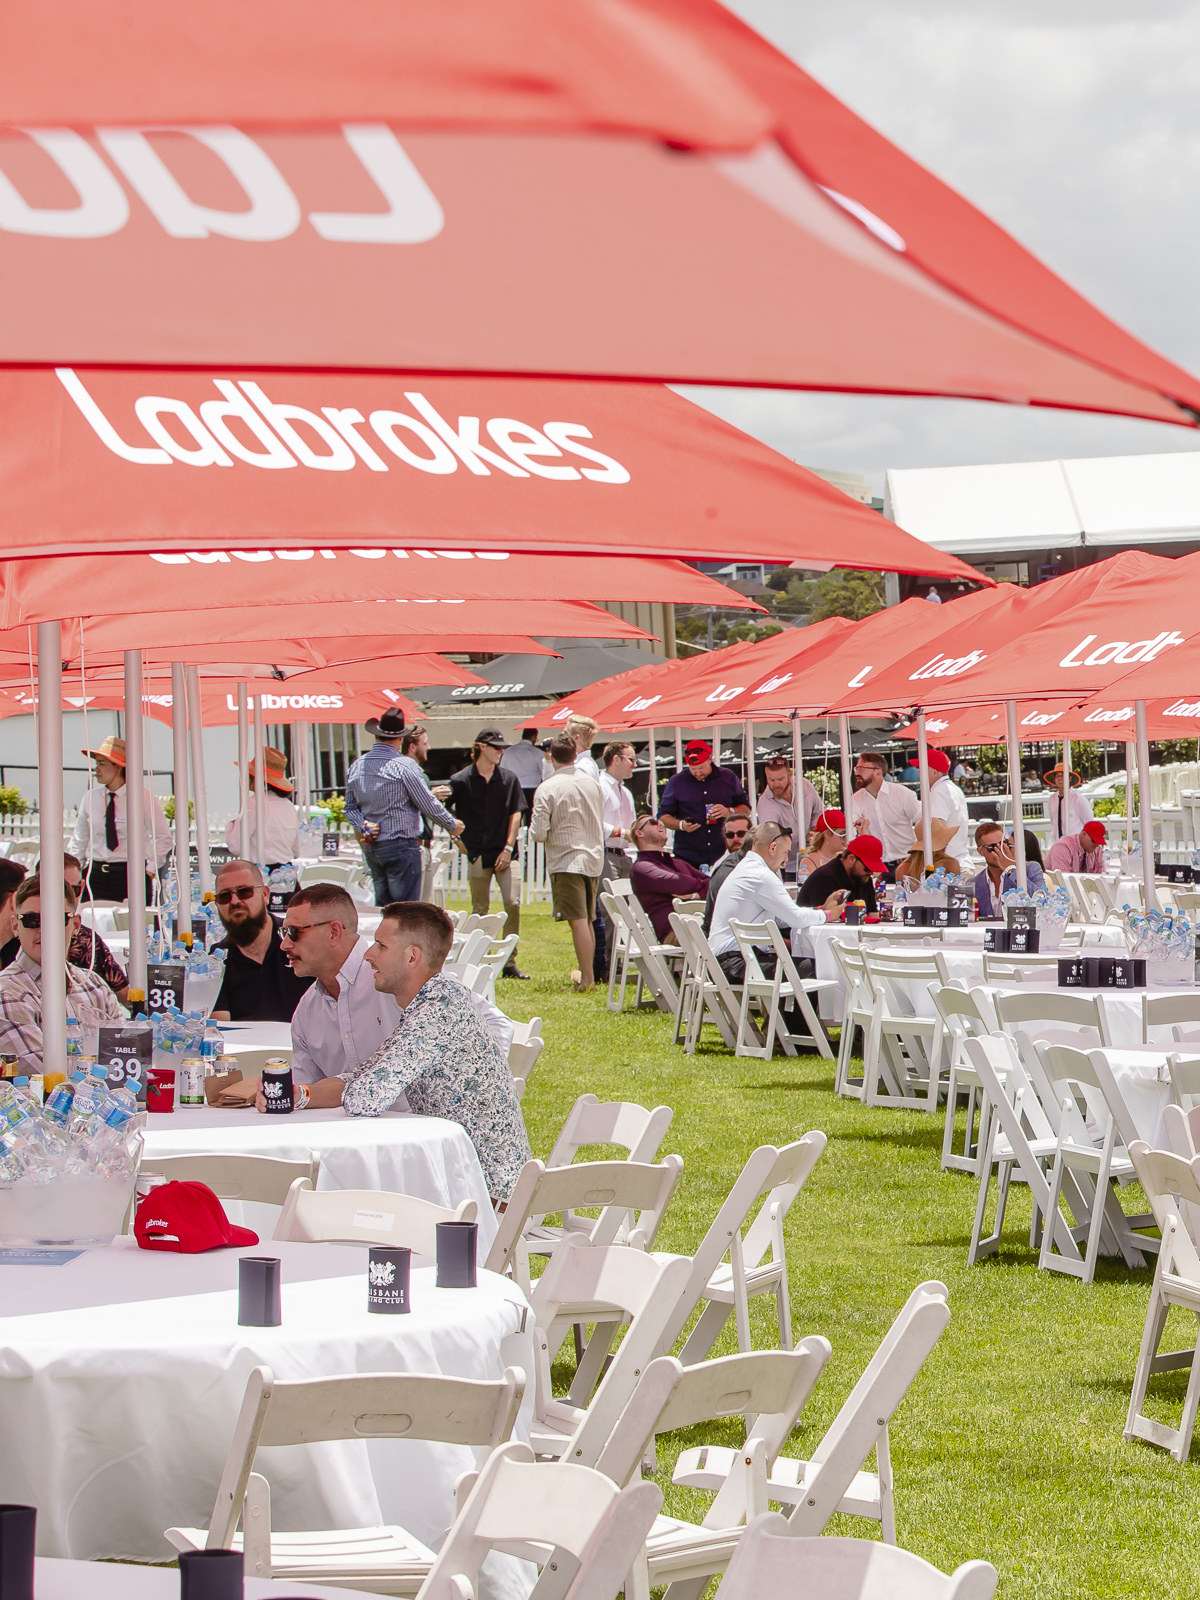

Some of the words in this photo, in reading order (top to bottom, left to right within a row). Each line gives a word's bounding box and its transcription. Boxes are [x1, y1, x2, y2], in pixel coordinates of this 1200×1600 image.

[54, 368, 631, 485] Ladbrokes
[324, 841, 337, 851] 33
[154, 979, 173, 987] TABLE
[149, 988, 176, 1008] 38
[114, 1046, 137, 1054] TABLE
[108, 1057, 142, 1082] 39
